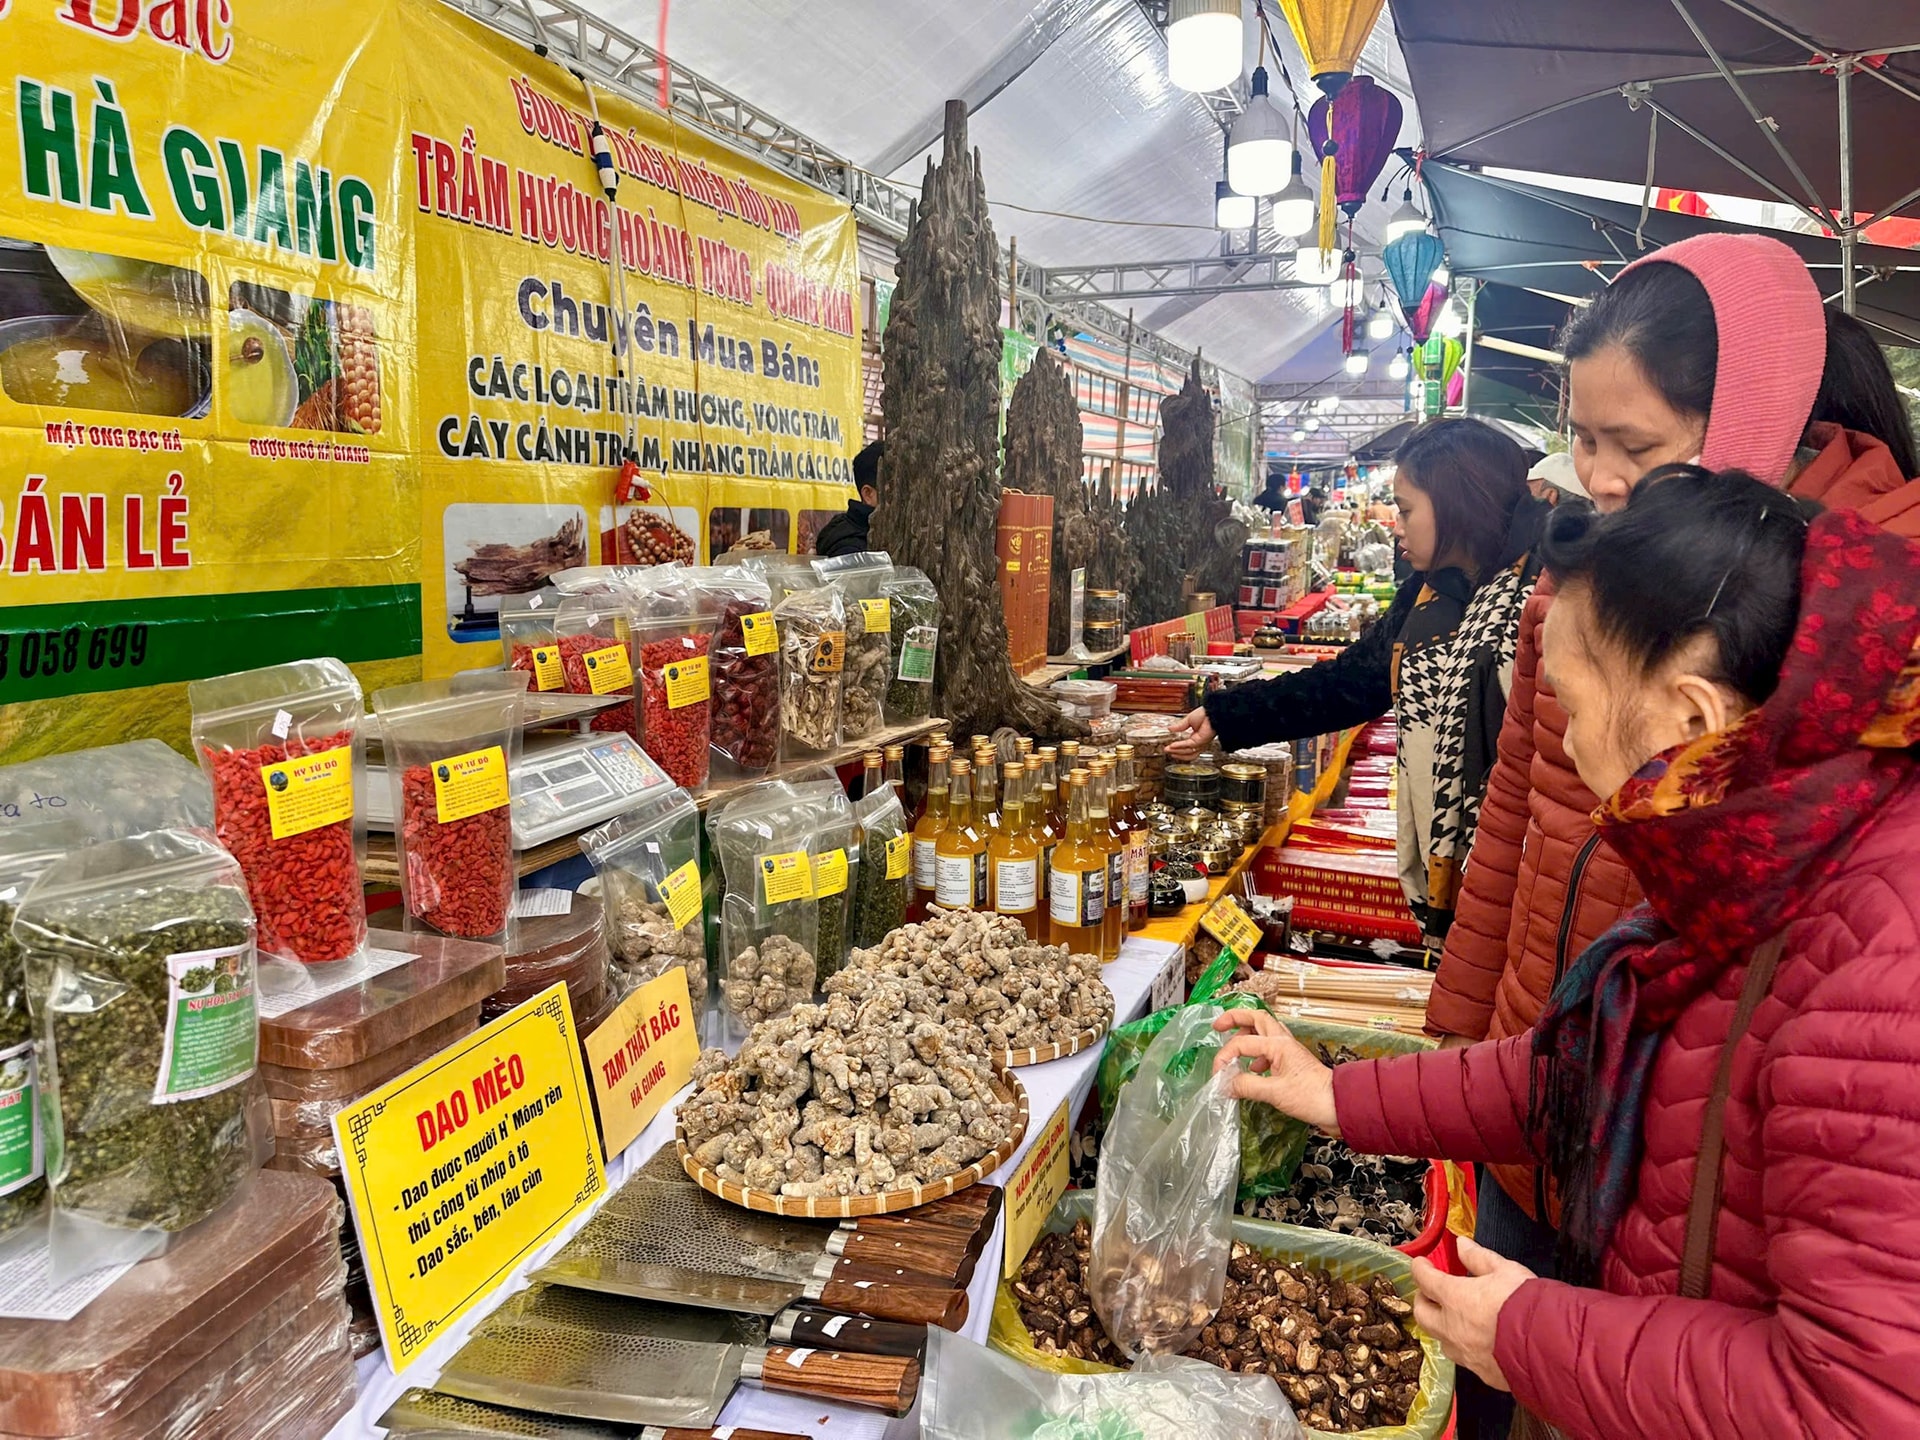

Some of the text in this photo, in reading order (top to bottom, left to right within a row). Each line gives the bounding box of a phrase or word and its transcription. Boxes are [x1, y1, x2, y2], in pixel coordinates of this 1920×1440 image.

[510, 75, 583, 156] CÔNG
[18, 77, 374, 270] HÀ GIANG
[412, 126, 513, 234] TRẦM
[517, 170, 611, 264] HƯƠNG
[617, 207, 695, 289] HOÀNG
[517, 277, 820, 388] Chuyên Mua Bán:
[468, 355, 528, 400] CÁC
[535, 368, 600, 413] LOẠI
[46, 420, 183, 453] MẬT ONG BẠC HÀ
[249, 438, 286, 460] RƯỢU
[289, 440, 315, 460] NGÔ
[334, 445, 369, 463] GIANG
[438, 416, 509, 459] CÂY
[517, 417, 590, 464] CẢNH
[673, 440, 745, 475] NHANG
[797, 450, 823, 480] CÁC
[125, 472, 191, 569] LẺ
[20, 627, 80, 679] 058
[88, 624, 148, 670] 699
[206, 994, 226, 1008] HOA
[602, 1055, 627, 1089] TAM
[653, 1001, 681, 1041] BẮC
[416, 1053, 525, 1152] DAO MÈO
[630, 1060, 667, 1109] HÀ GIANG
[401, 1181, 428, 1210] Dao
[431, 1156, 462, 1194] được
[464, 1129, 497, 1173] người
[513, 1101, 544, 1128] Mông
[545, 1084, 563, 1110] rèn
[407, 1140, 530, 1245] thủ công từ nhíp ô tô
[417, 1248, 444, 1277] Dao
[447, 1227, 474, 1256] sắc,
[475, 1203, 501, 1232] bén,
[502, 1184, 520, 1210] lâu
[521, 1166, 543, 1196] cùn
